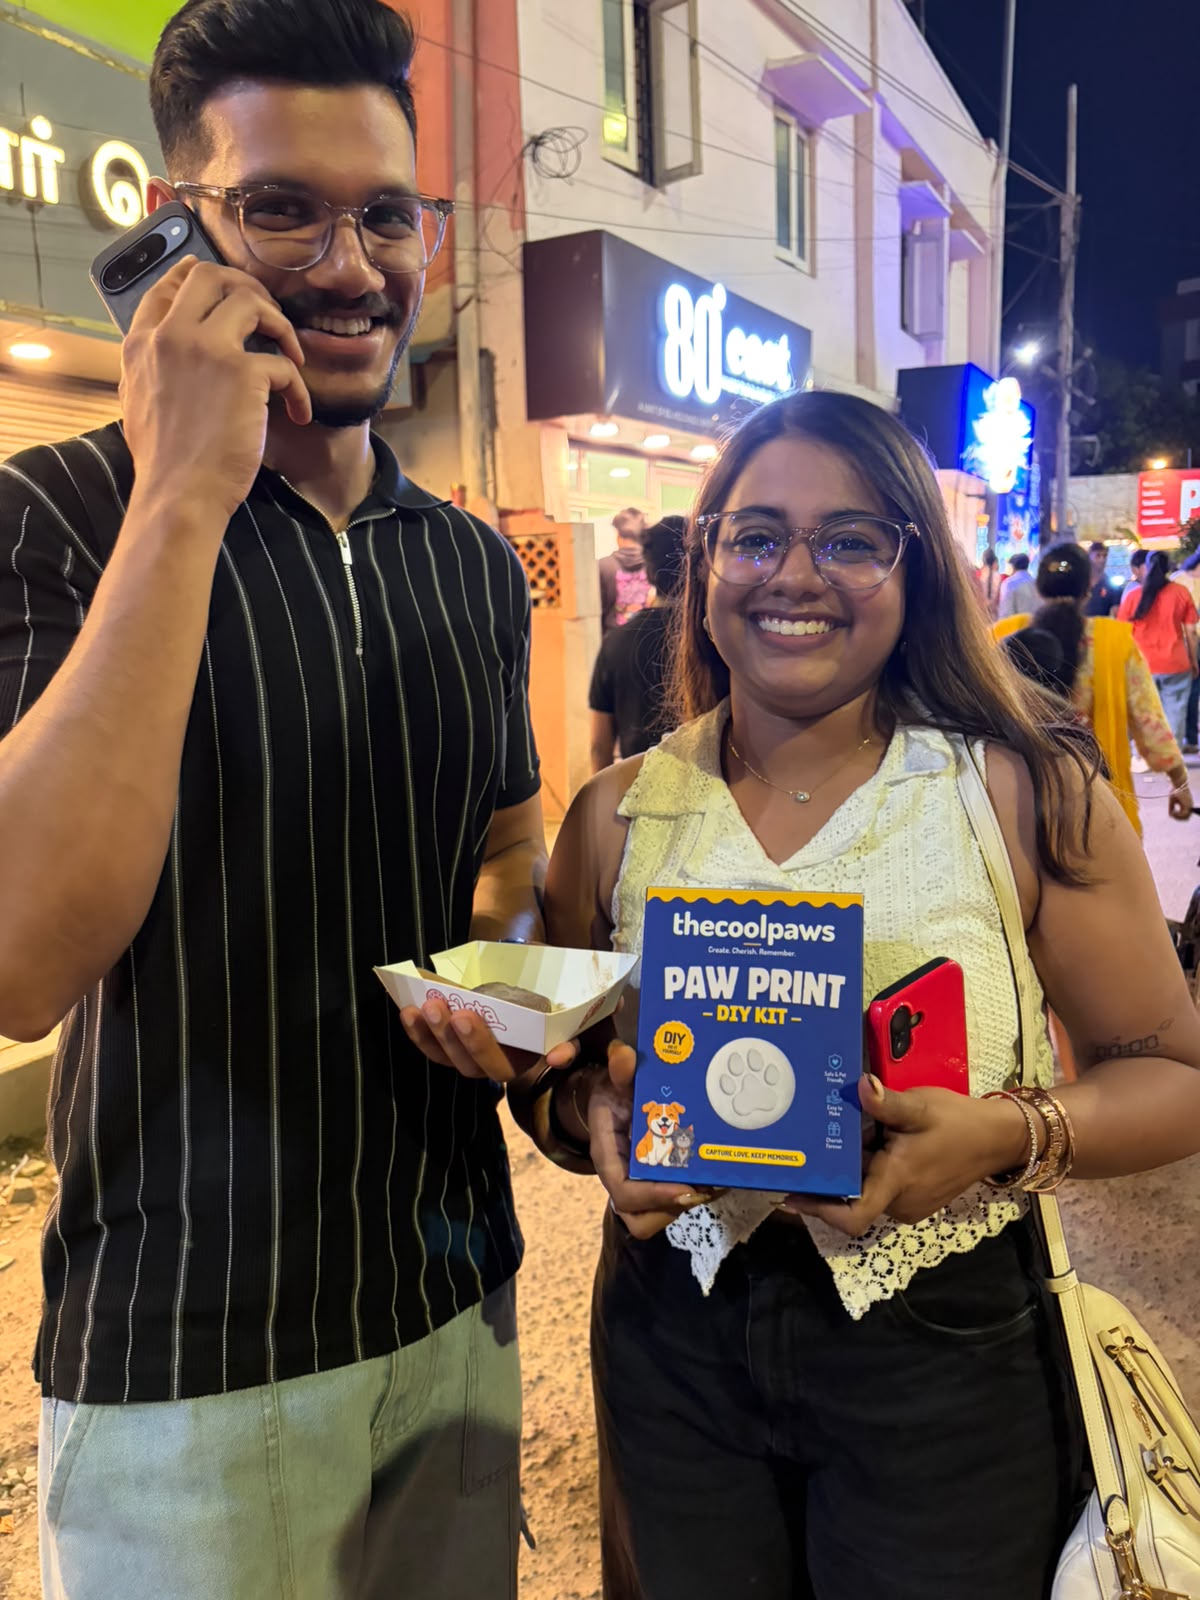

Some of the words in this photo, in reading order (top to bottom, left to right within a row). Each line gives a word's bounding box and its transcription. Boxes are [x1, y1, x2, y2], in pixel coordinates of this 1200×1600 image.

[672, 911, 836, 946] thecoolpaws
[708, 946, 731, 954] Create.
[758, 948, 797, 957] Remember.
[664, 966, 740, 1000] PAW
[747, 967, 846, 1009] PRINT
[716, 1004, 752, 1023] DIY
[754, 1006, 788, 1025] KIT
[663, 1030, 686, 1046] DIY
[705, 1148, 732, 1157] CAPTURE
[733, 1150, 749, 1158] LOVE.
[767, 1154, 799, 1162] MEMORIES.
